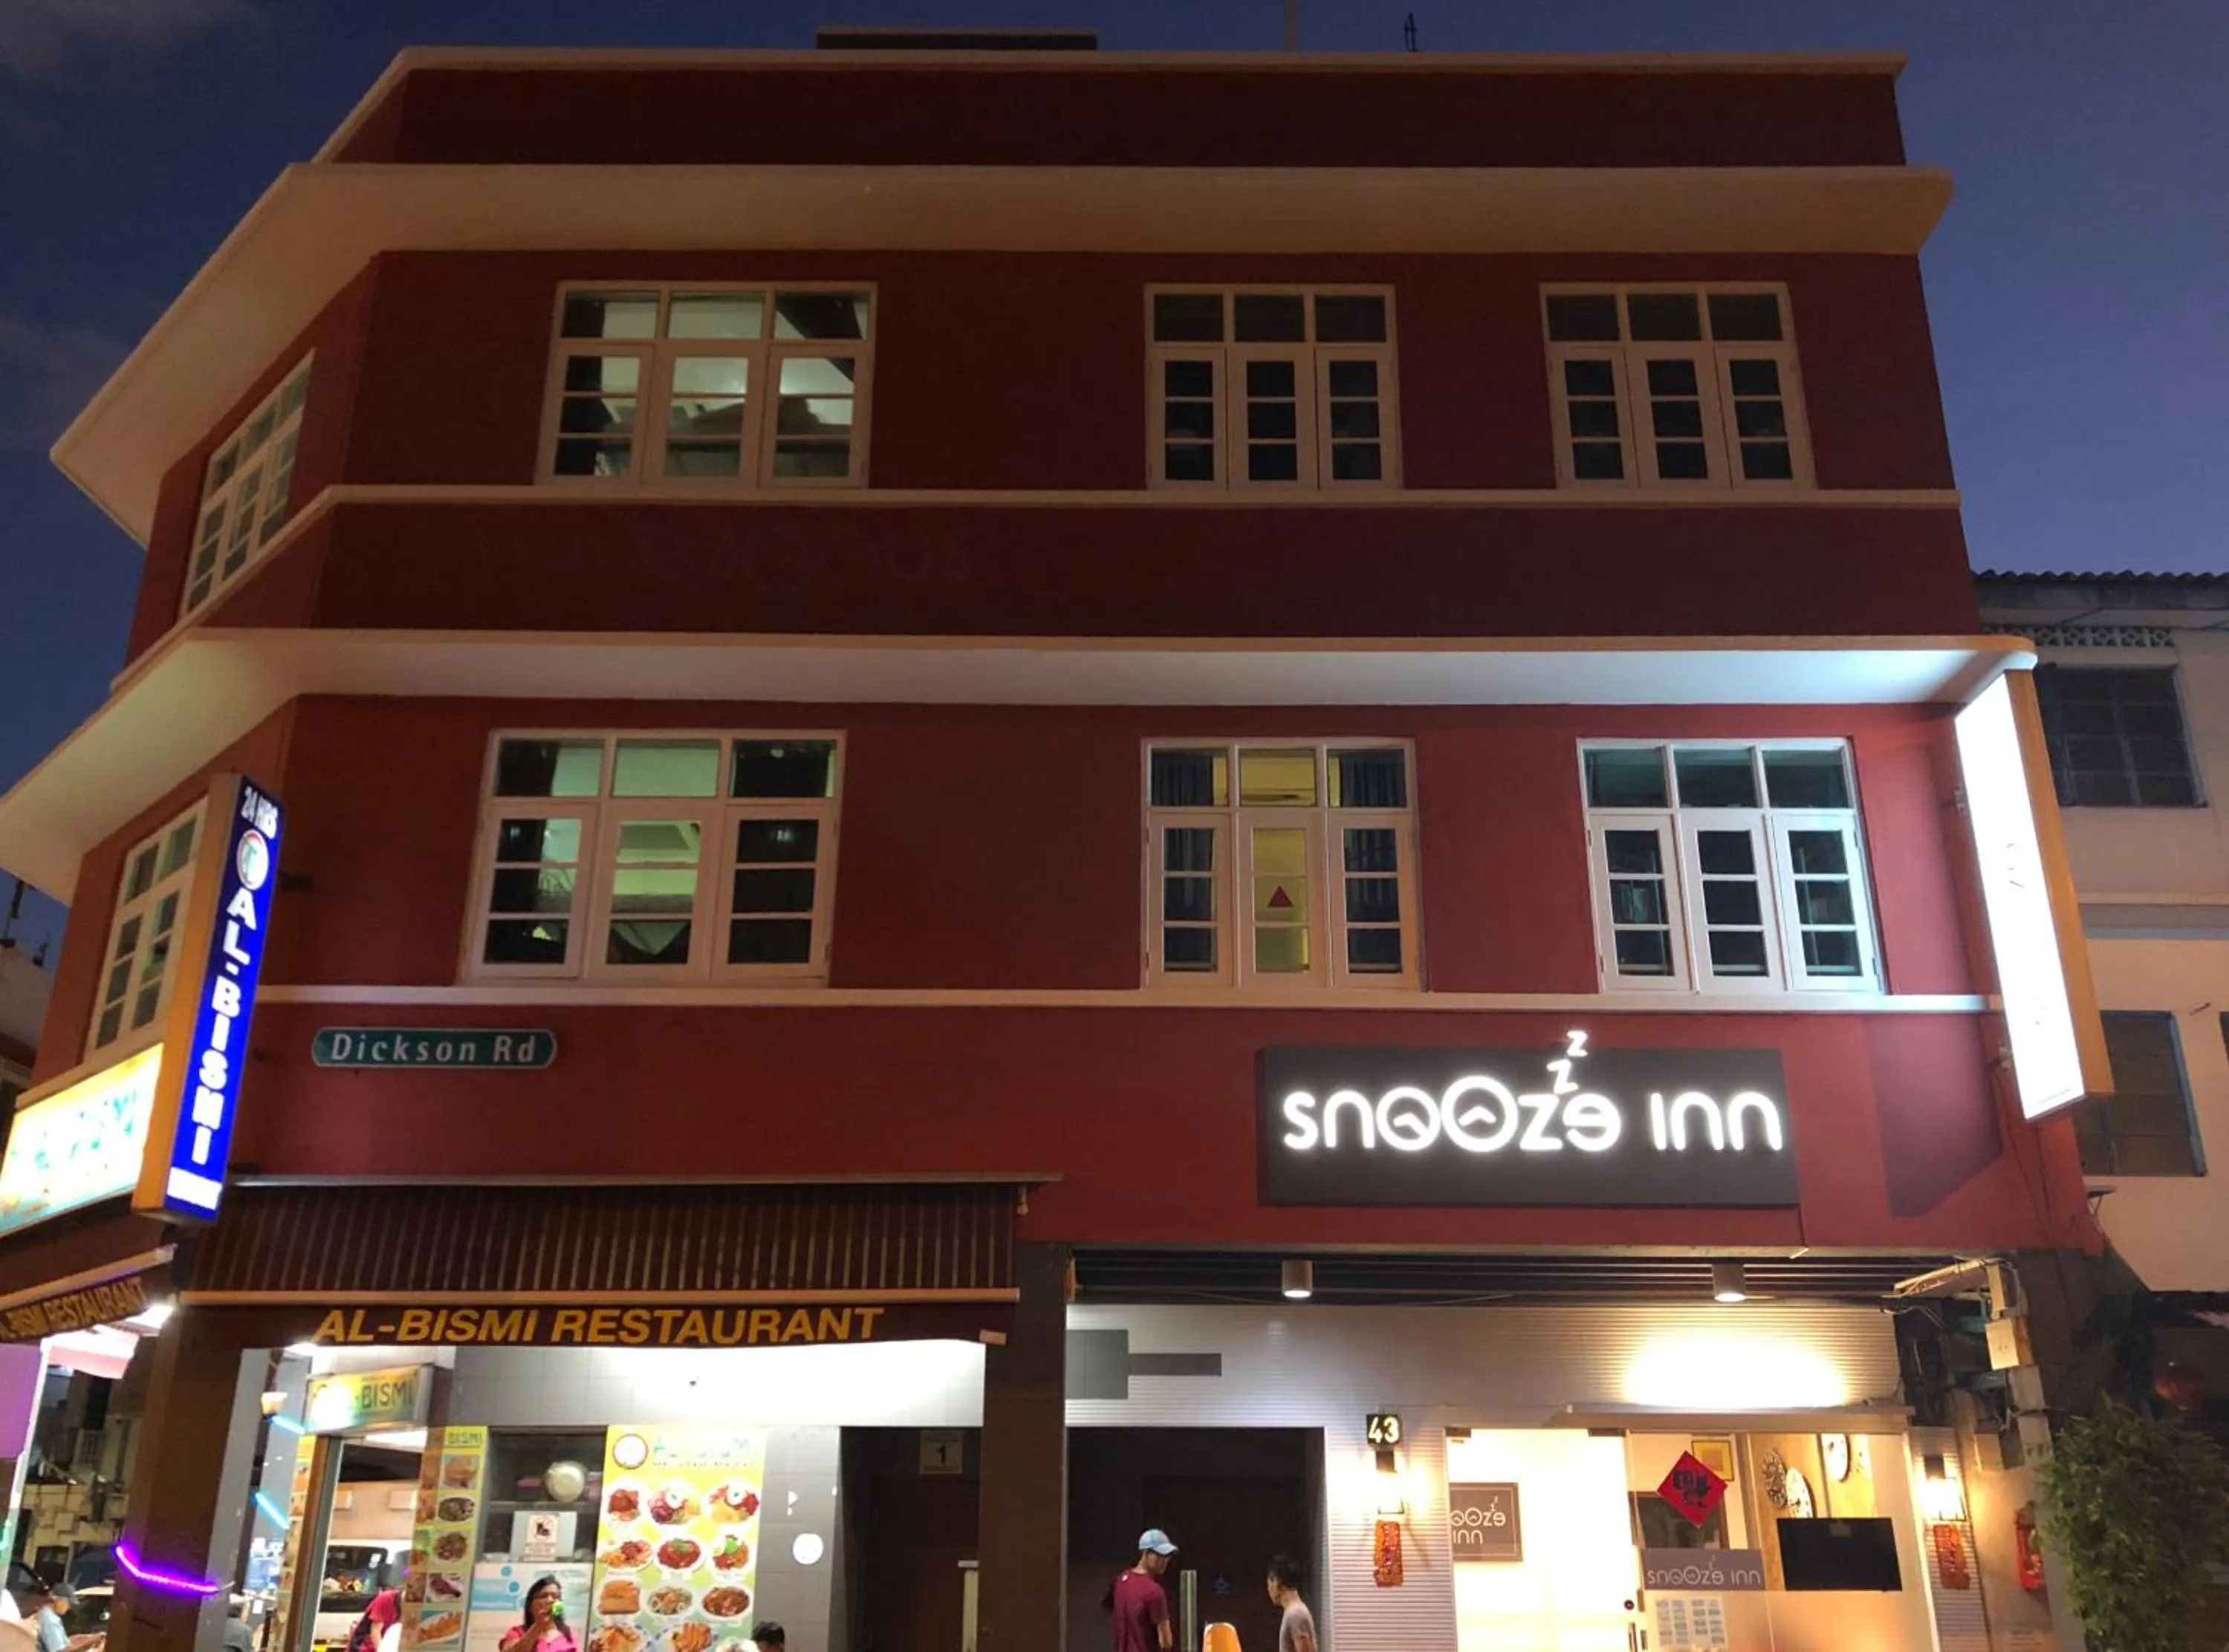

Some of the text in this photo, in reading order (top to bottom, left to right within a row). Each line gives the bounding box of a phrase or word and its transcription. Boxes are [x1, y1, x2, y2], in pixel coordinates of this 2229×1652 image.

[331, 1033, 536, 1063] Dickson Rd
[42, 1275, 147, 1333] RESTAURANT
[313, 1307, 884, 1344] AL-BISMI RESTAURANT
[1368, 1416, 1399, 1443] 43
[936, 1444, 946, 1465] 1
